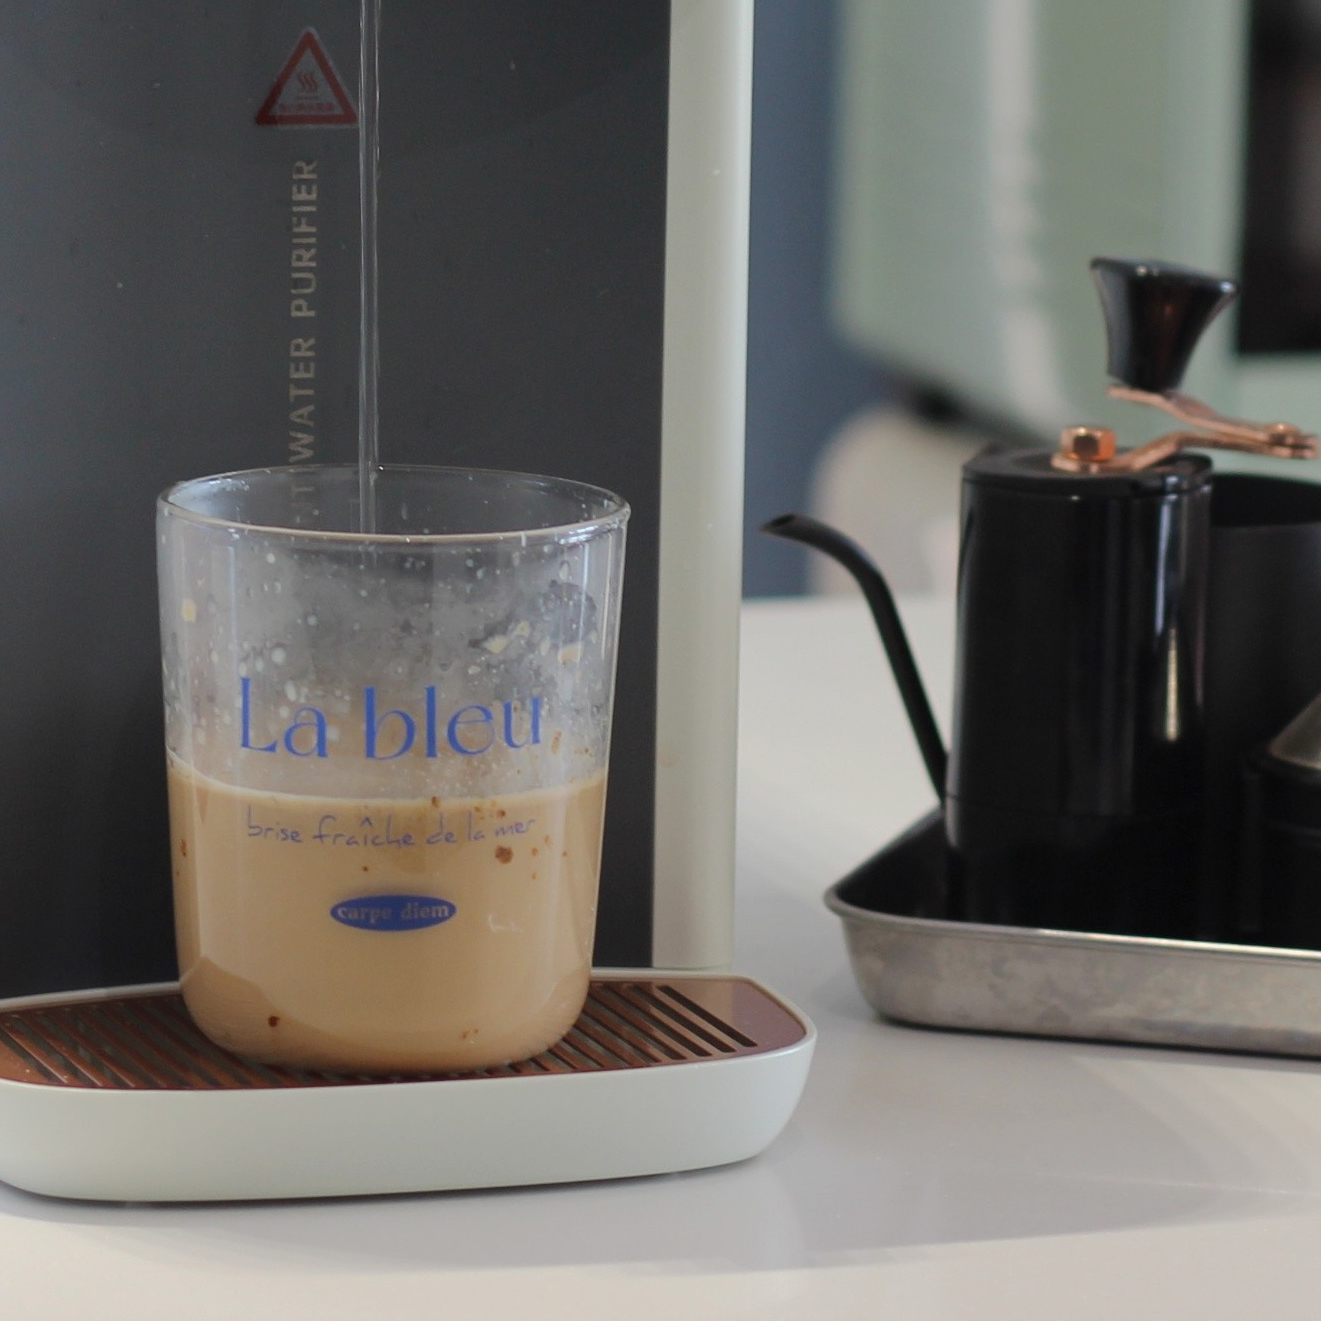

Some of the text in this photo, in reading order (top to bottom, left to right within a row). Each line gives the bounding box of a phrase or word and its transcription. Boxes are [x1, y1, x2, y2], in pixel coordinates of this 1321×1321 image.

[291, 160, 318, 317] PURIFIER
[289, 338, 316, 463] WATER
[240, 678, 542, 760] La bleu
[248, 805, 303, 844] brise
[426, 813, 457, 845] de
[468, 811, 486, 842] la
[495, 819, 536, 837] mer
[337, 902, 449, 924] carpe diem
